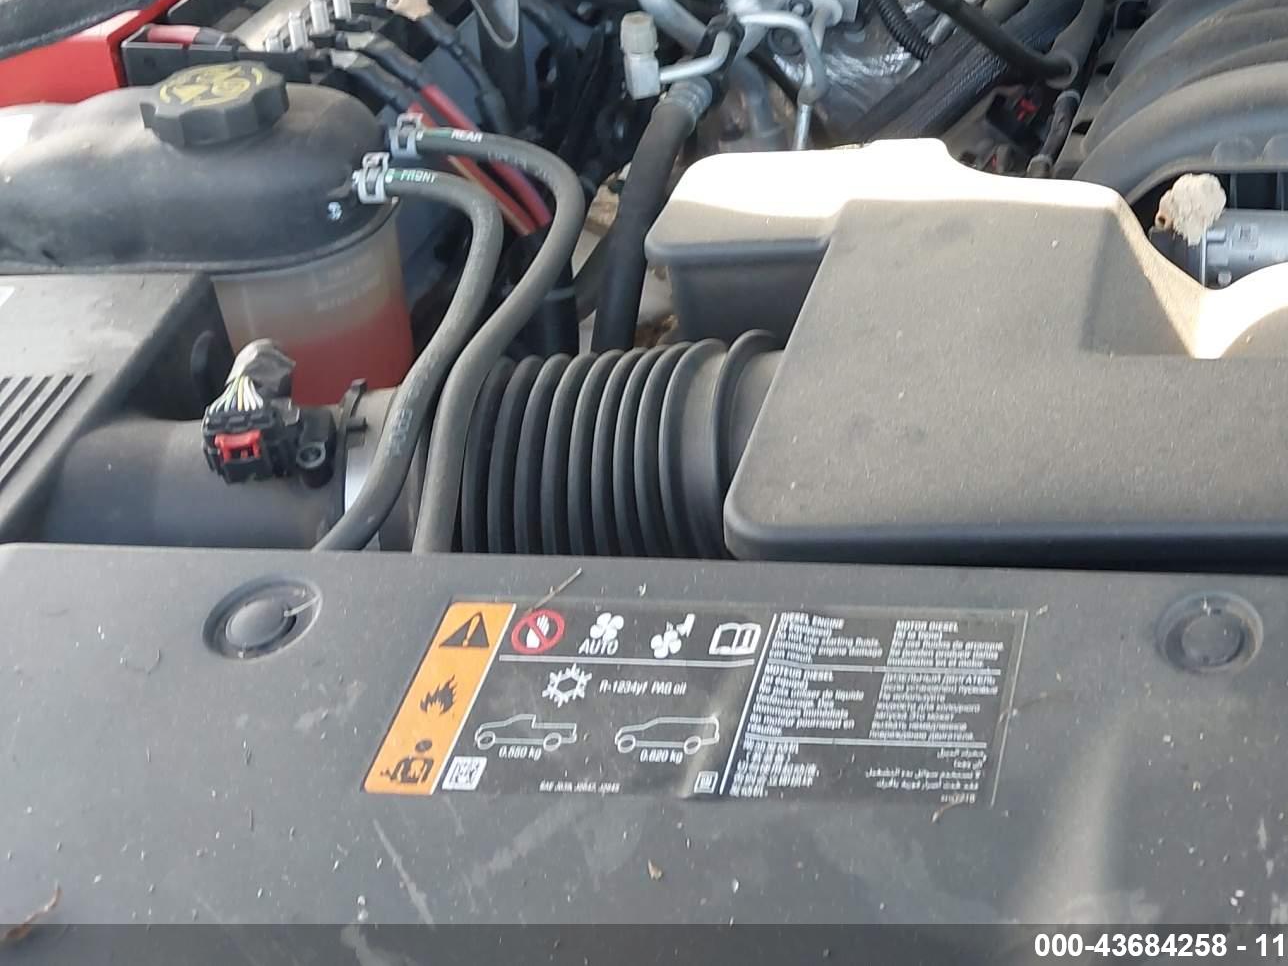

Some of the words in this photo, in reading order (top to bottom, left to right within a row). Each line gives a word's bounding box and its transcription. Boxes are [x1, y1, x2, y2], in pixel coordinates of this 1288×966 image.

[451, 129, 484, 143] REAR
[400, 170, 438, 184] FRONT
[811, 615, 845, 630] ENGINE
[578, 638, 619, 655] AUTO
[599, 679, 646, 696] R-1234yf
[673, 681, 687, 695] oil
[528, 747, 542, 761] kg
[669, 750, 684, 765] kg
